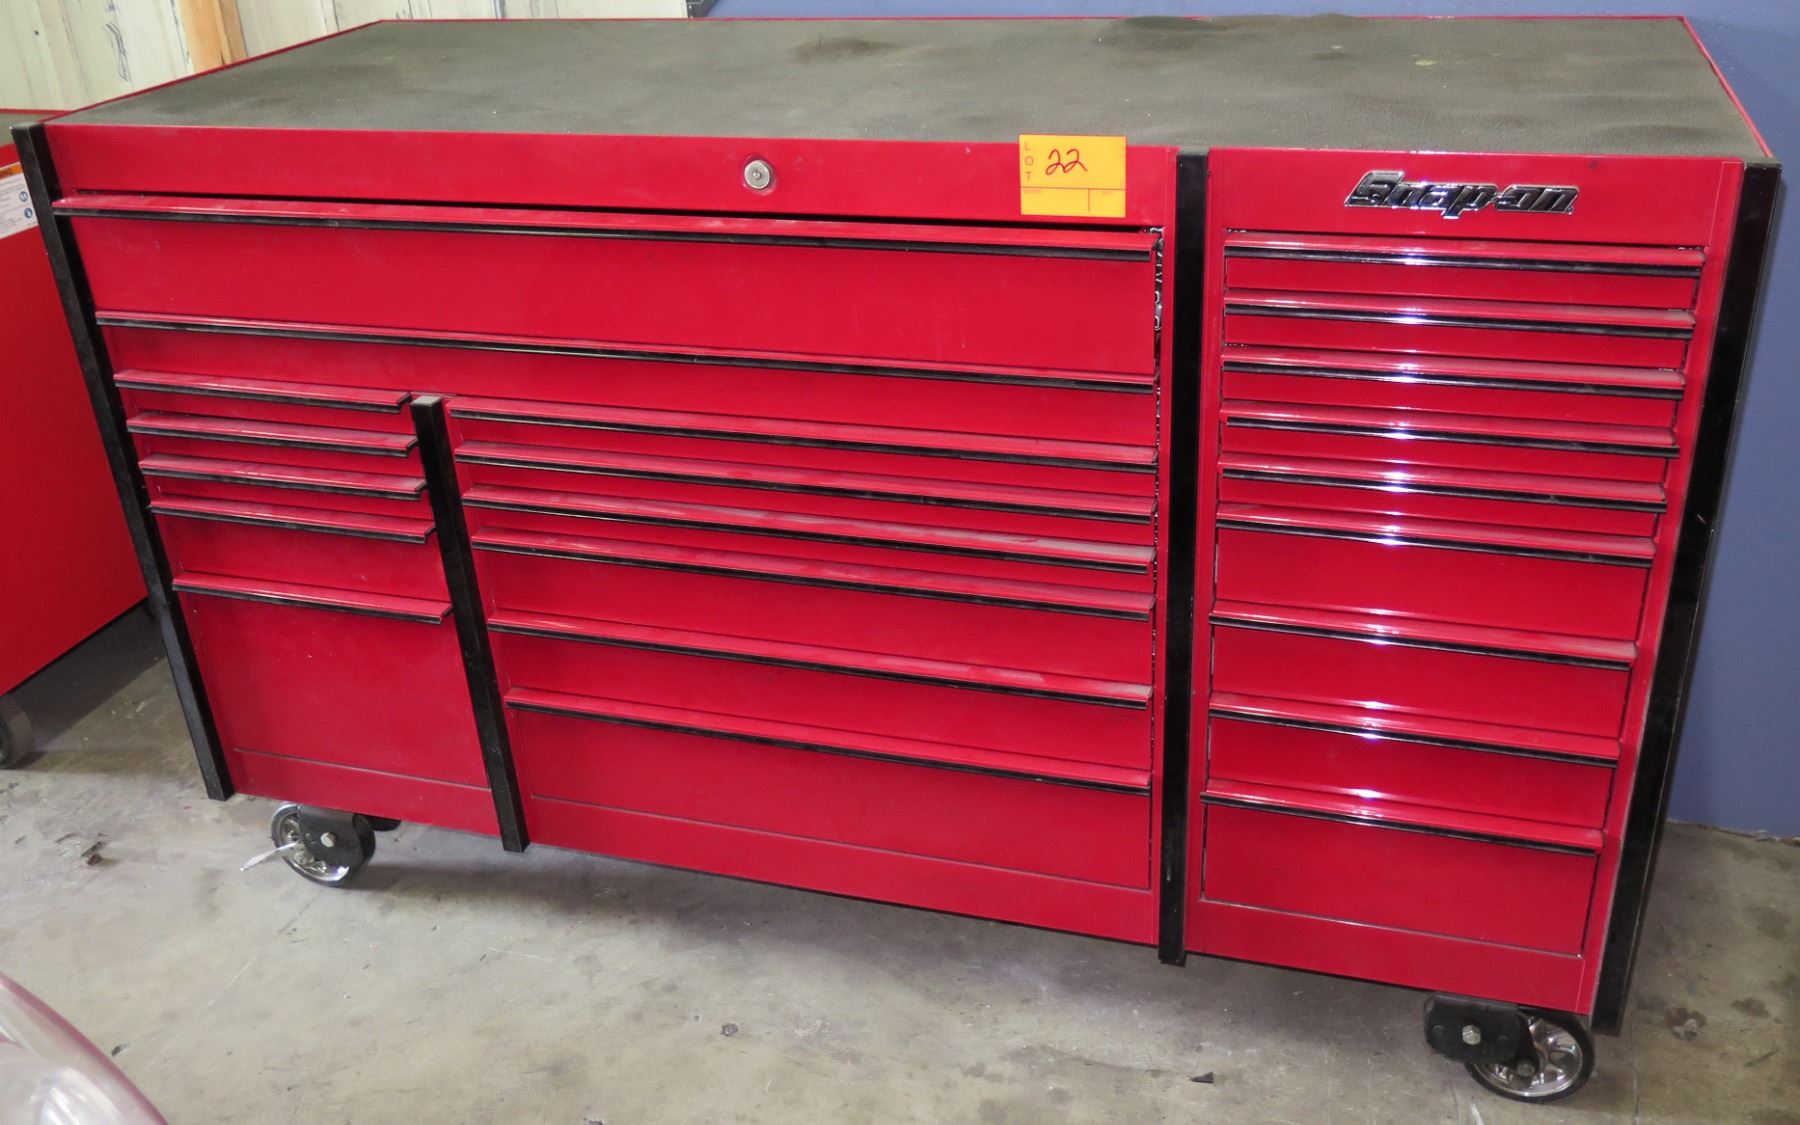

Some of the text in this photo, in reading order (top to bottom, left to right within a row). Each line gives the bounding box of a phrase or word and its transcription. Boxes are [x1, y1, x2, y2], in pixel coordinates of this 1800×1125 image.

[1024, 141, 1034, 181] LOT
[1045, 148, 1088, 175] 22
[1344, 170, 1579, 219] Snap-on
